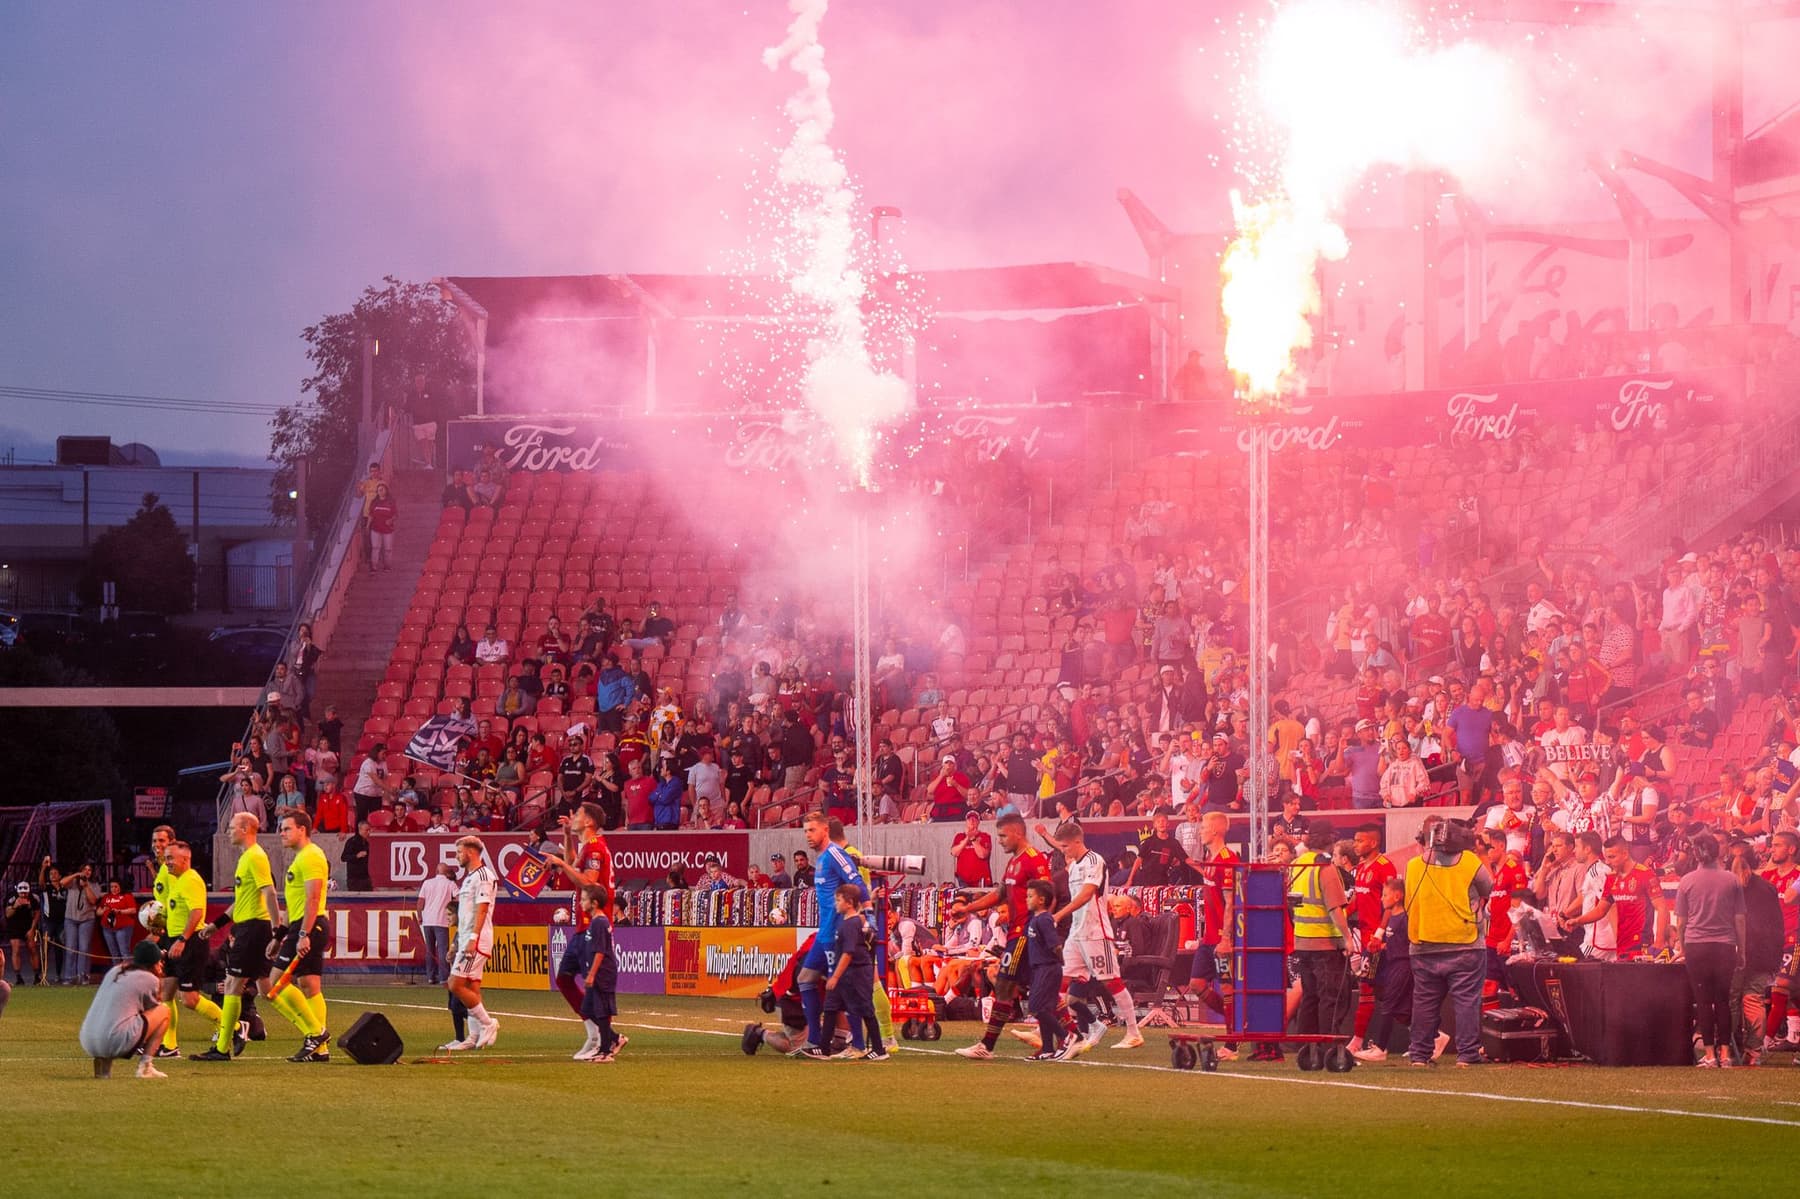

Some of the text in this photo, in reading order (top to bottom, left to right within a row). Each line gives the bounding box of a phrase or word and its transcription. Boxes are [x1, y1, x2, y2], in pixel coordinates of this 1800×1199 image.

[495, 424, 603, 471] Ford
[1544, 744, 1612, 761] BELIEVE
[321, 908, 428, 961] LIE
[521, 943, 549, 975] TIRE
[615, 943, 665, 974] Soccer.net
[1089, 955, 1106, 969] 18
[1214, 957, 1230, 974] 15
